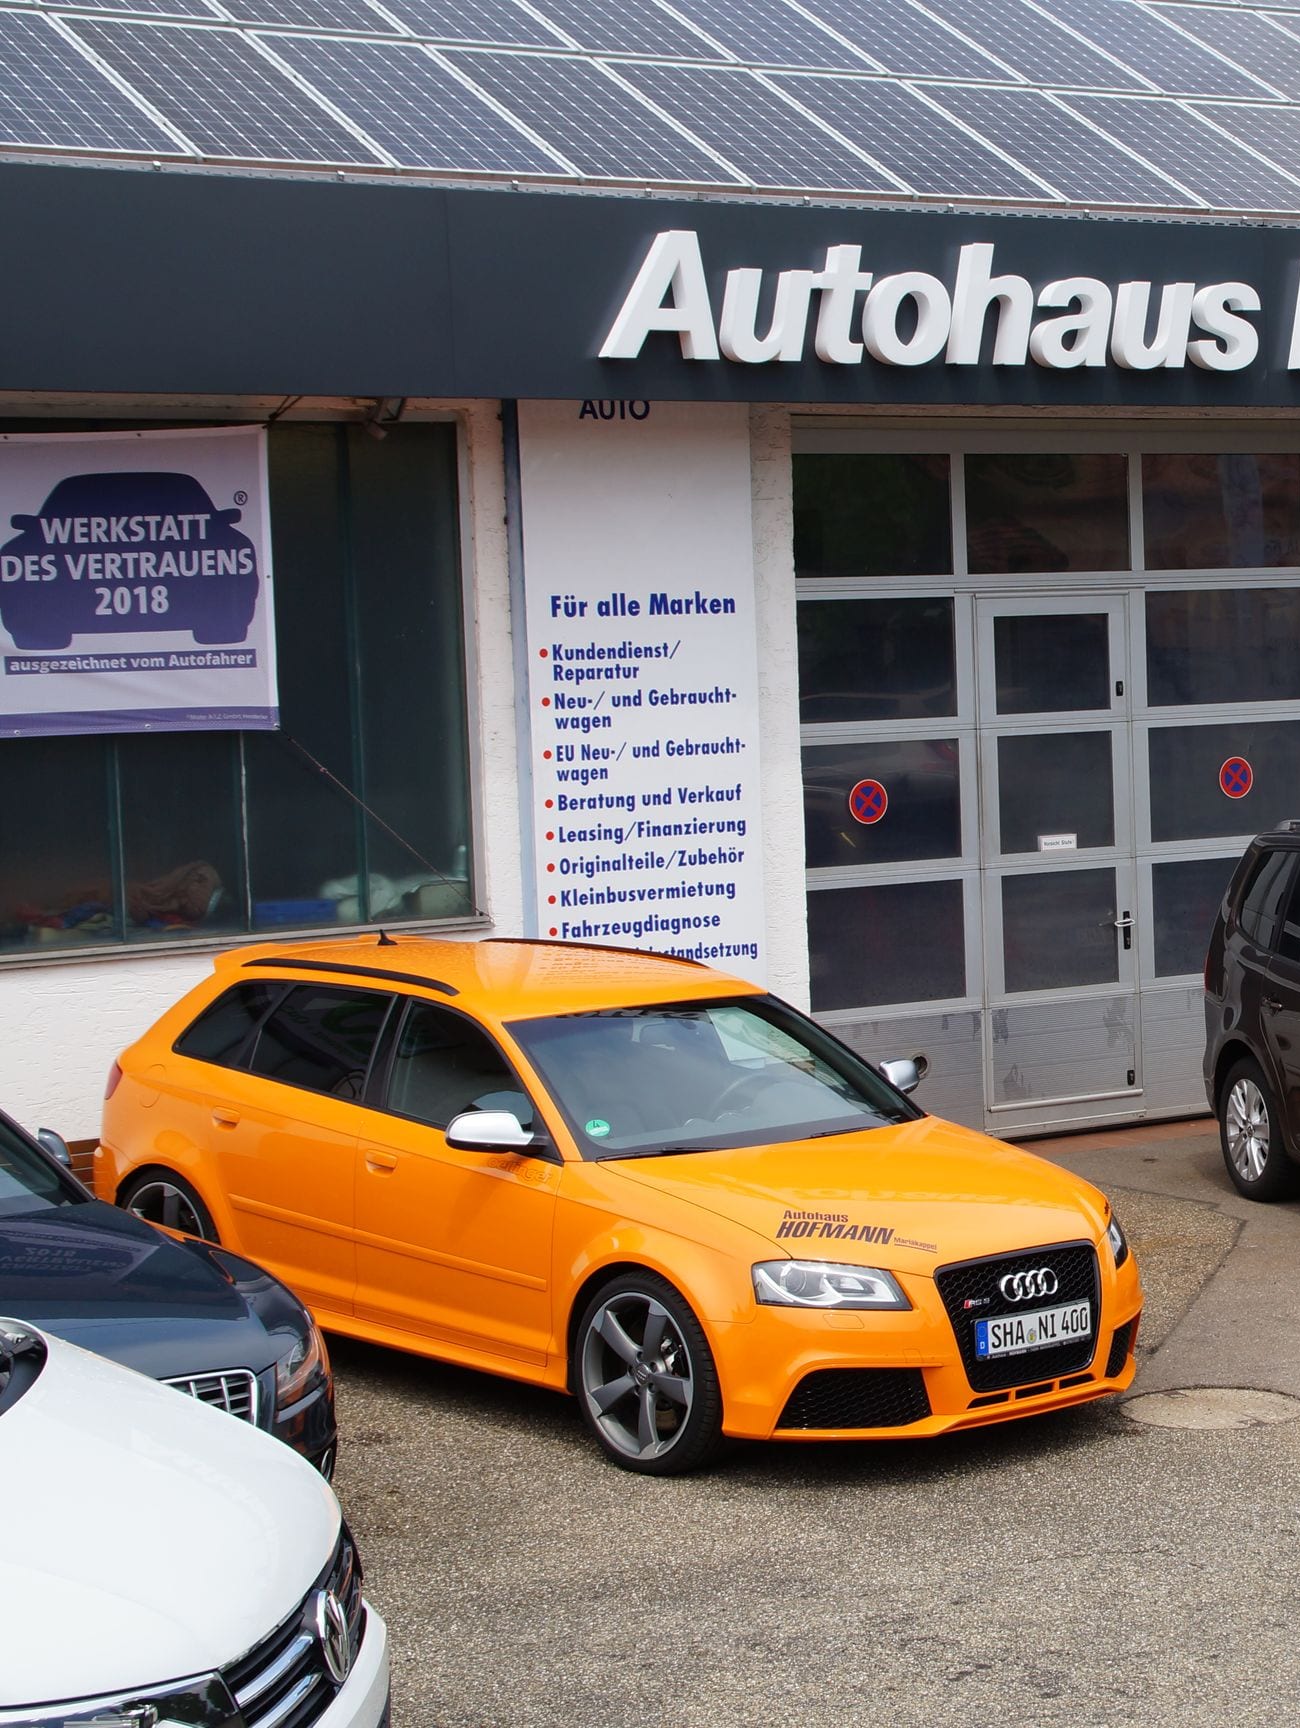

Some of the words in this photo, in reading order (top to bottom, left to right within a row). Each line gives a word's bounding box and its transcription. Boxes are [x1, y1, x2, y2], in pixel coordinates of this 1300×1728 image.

[598, 229, 1262, 371] Autohaus
[40, 514, 211, 544] WERKSTATT
[1, 555, 58, 582] DES
[64, 548, 254, 580] VERTRAUENS
[95, 585, 169, 615] 2018
[551, 595, 588, 618] Für
[597, 593, 641, 617] alle
[649, 591, 736, 615] Marken
[10, 656, 127, 674] ausgezeichnet
[130, 656, 165, 668] vom
[168, 652, 253, 668] Autofahrer
[552, 640, 681, 661] Kundendienst/
[554, 664, 639, 685] Reparatur
[611, 690, 643, 708] und
[649, 687, 737, 707] Gebraucht-
[555, 714, 612, 734] wagen
[556, 745, 574, 762] EU
[632, 740, 660, 759] und
[666, 737, 746, 757] Gebraucht-
[557, 766, 609, 786] wagen
[558, 793, 636, 813] Beratung
[642, 788, 672, 806] und
[678, 783, 742, 804] Verkauf
[560, 881, 736, 908] Kleinbusvermietung
[562, 912, 721, 939] Fahrzeugdiagnose
[783, 1210, 848, 1222] Autohaus
[776, 1221, 895, 1245] HOFMANN
[991, 1319, 1025, 1349] SHA
[1039, 1313, 1057, 1340] NI
[1061, 1307, 1088, 1335] 400
